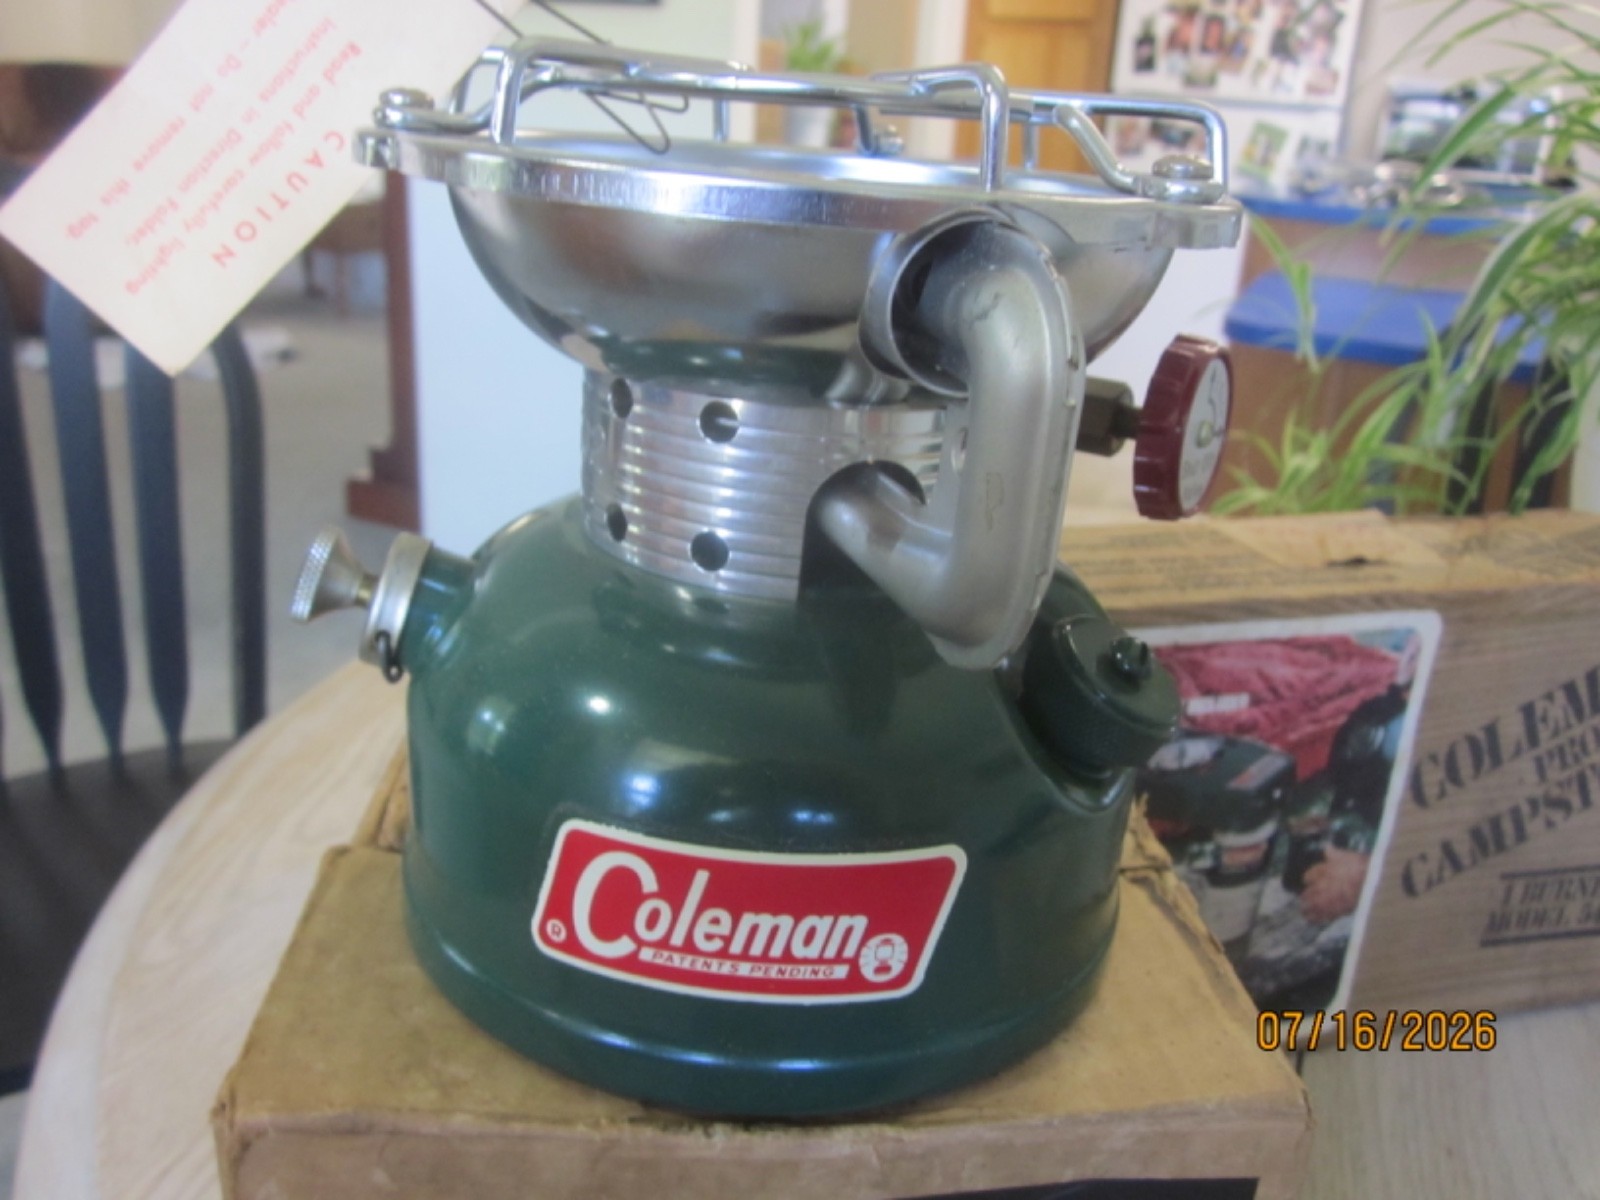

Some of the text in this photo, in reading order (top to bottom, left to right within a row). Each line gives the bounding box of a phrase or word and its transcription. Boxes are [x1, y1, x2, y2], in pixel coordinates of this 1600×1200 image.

[124, 40, 362, 294] Read and follow carefully lighting
[132, 115, 186, 172] remove
[178, 127, 243, 193] Direction
[211, 130, 346, 269] CAUTION
[573, 851, 869, 959] Coleman
[652, 951, 836, 979] PATENTS PENDING
